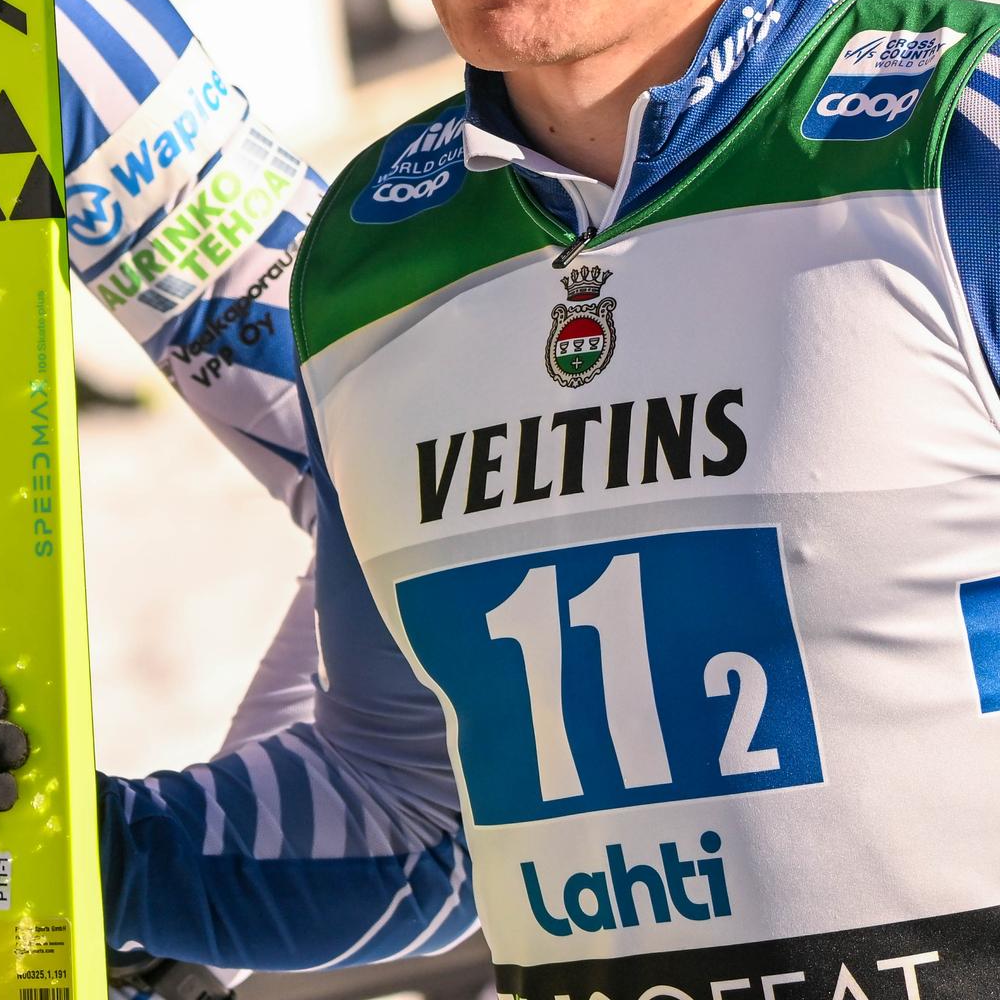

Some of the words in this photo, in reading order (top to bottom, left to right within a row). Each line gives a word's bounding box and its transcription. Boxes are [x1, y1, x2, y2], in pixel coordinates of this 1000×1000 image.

[875, 60, 913, 68] WORLD
[880, 43, 946, 60] COUNTRY
[886, 38, 936, 49] CROSS
[110, 69, 229, 198] Wapice
[816, 88, 920, 122] coop
[99, 169, 242, 312] AURINKO
[178, 168, 292, 281] TEHOA
[372, 170, 450, 203] coop
[30, 380, 54, 557] SPEEDMAX
[416, 388, 748, 525] VELTINS
[484, 551, 674, 803] 11
[702, 650, 782, 777] 2
[519, 829, 733, 938] Lahti
